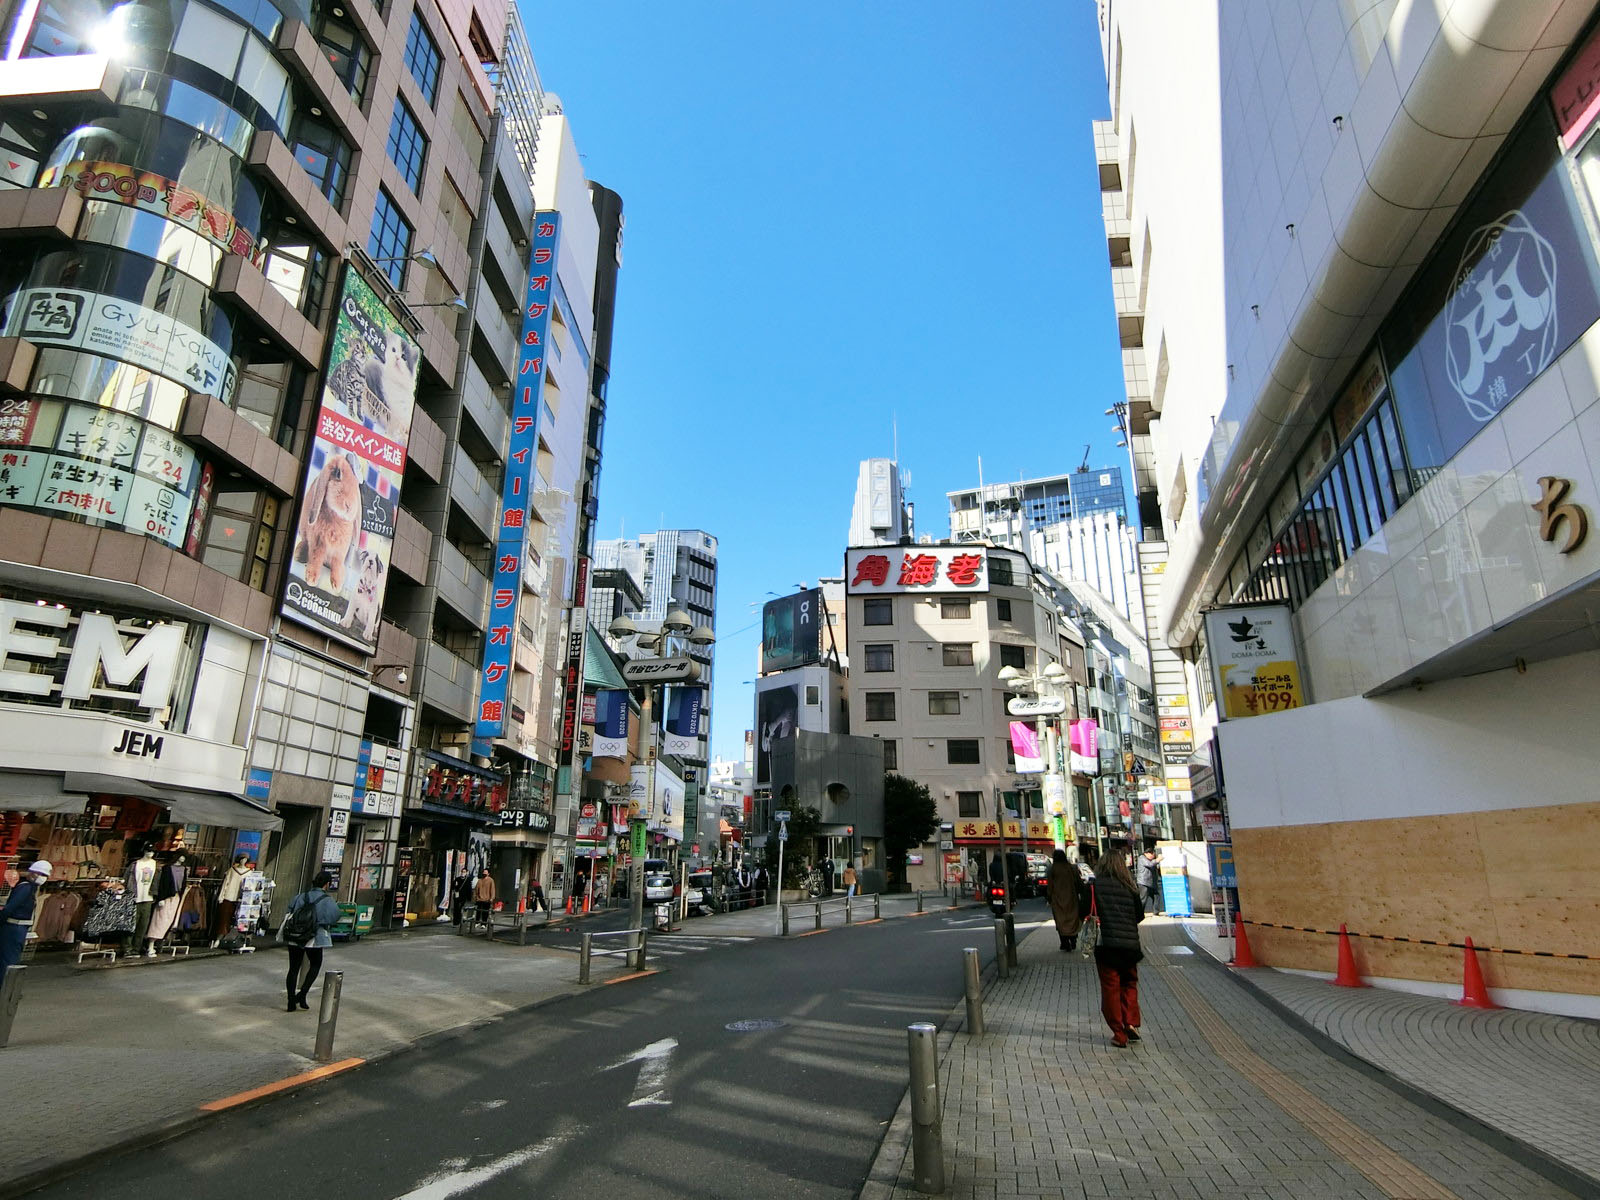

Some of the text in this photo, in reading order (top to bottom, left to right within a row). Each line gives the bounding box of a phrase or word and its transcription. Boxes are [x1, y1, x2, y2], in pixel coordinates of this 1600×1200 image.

[101, 304, 221, 372] Gyu-Kaku
[355, 309, 369, 331] Cat
[370, 327, 386, 352] Cafe
[186, 362, 217, 388] 4F
[503, 222, 555, 528] カラオケ&パーティー館
[1, 399, 29, 414] 24
[321, 414, 402, 467] 渋谷スペイン坂店
[144, 502, 179, 526] たばこ
[146, 520, 172, 538] OK!
[1530, 475, 1588, 553] ち
[852, 553, 982, 587] 角海老
[301, 596, 342, 624] COO&RIKU
[481, 555, 518, 722] カラオケ館
[627, 661, 689, 675] 渋谷センター街
[1244, 691, 1292, 711] ¥199
[1252, 684, 1294, 692] ハイボール
[562, 699, 576, 752] union
[618, 702, 627, 735] TOKYO 2020
[689, 700, 699, 734] TOKYO 2020
[113, 729, 164, 760] JEM
